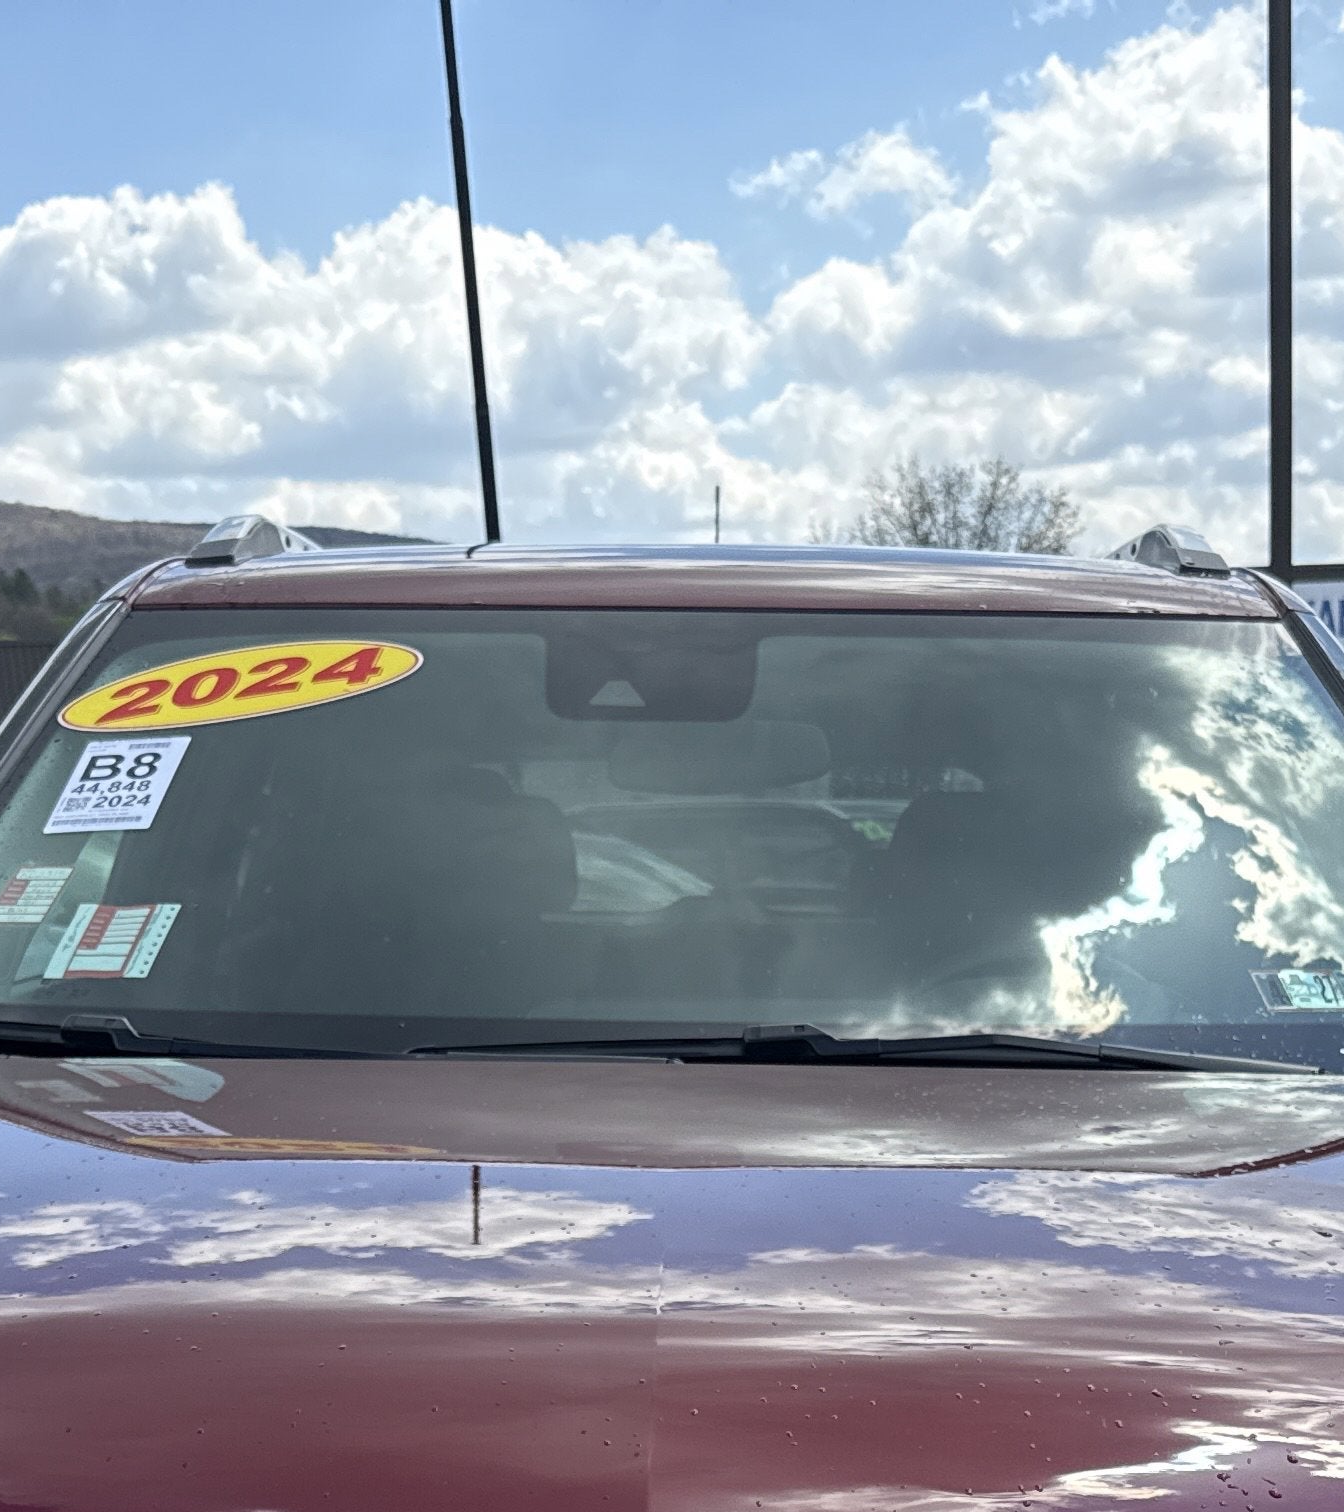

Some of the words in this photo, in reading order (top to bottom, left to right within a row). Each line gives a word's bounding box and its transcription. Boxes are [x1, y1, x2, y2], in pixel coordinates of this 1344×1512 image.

[94, 646, 385, 725] 2024
[79, 752, 162, 782] B8
[71, 780, 151, 795] 44,848
[92, 794, 152, 809] 2024
